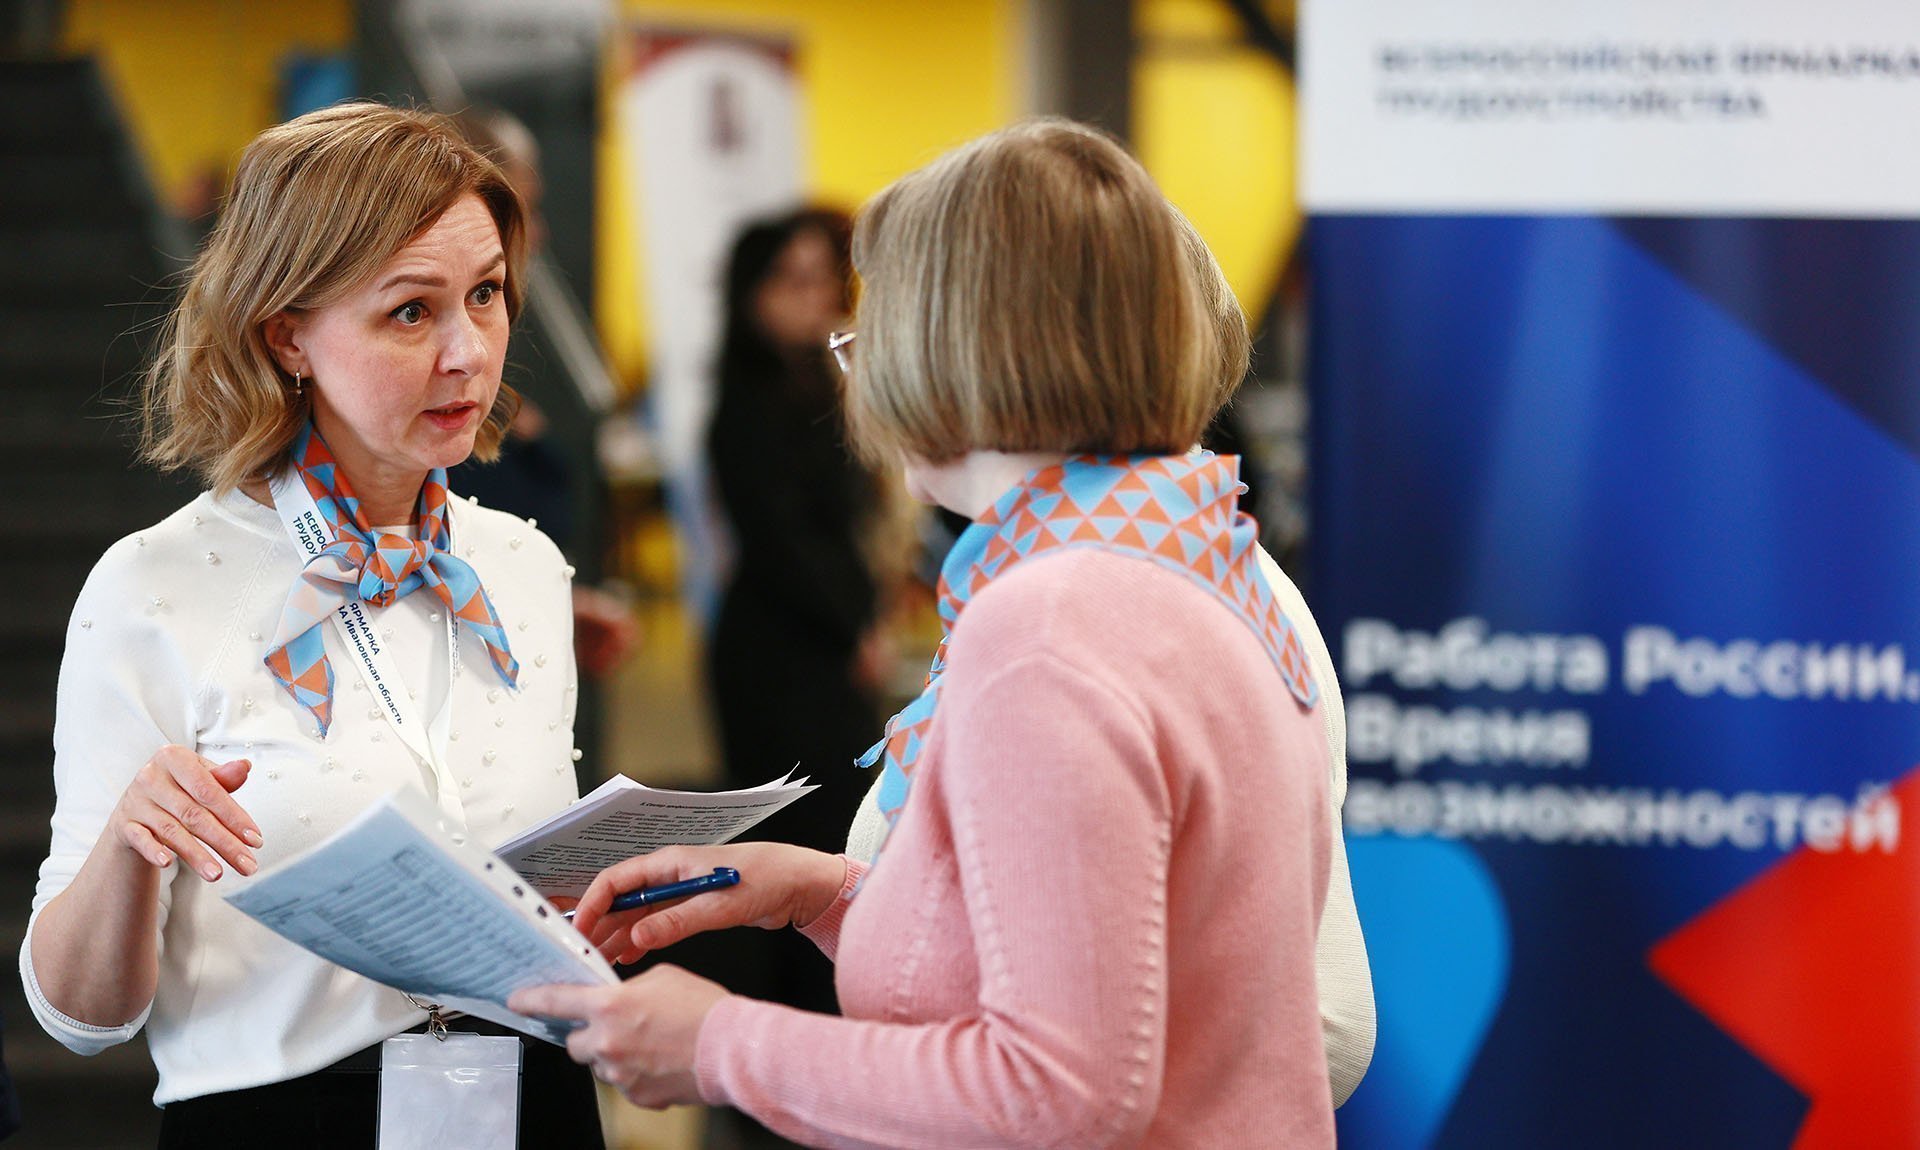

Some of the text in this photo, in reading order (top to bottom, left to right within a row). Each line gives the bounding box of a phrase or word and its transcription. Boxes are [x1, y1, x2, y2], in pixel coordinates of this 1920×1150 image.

[293, 516, 319, 556] ТРУДОУ
[349, 602, 381, 656] ЯРМАРКА
[1344, 618, 1607, 693] Работа
[344, 619, 381, 682] Ивановская
[378, 683, 403, 726] область
[1347, 695, 1591, 774] Время
[1345, 779, 1899, 853] возможностей
